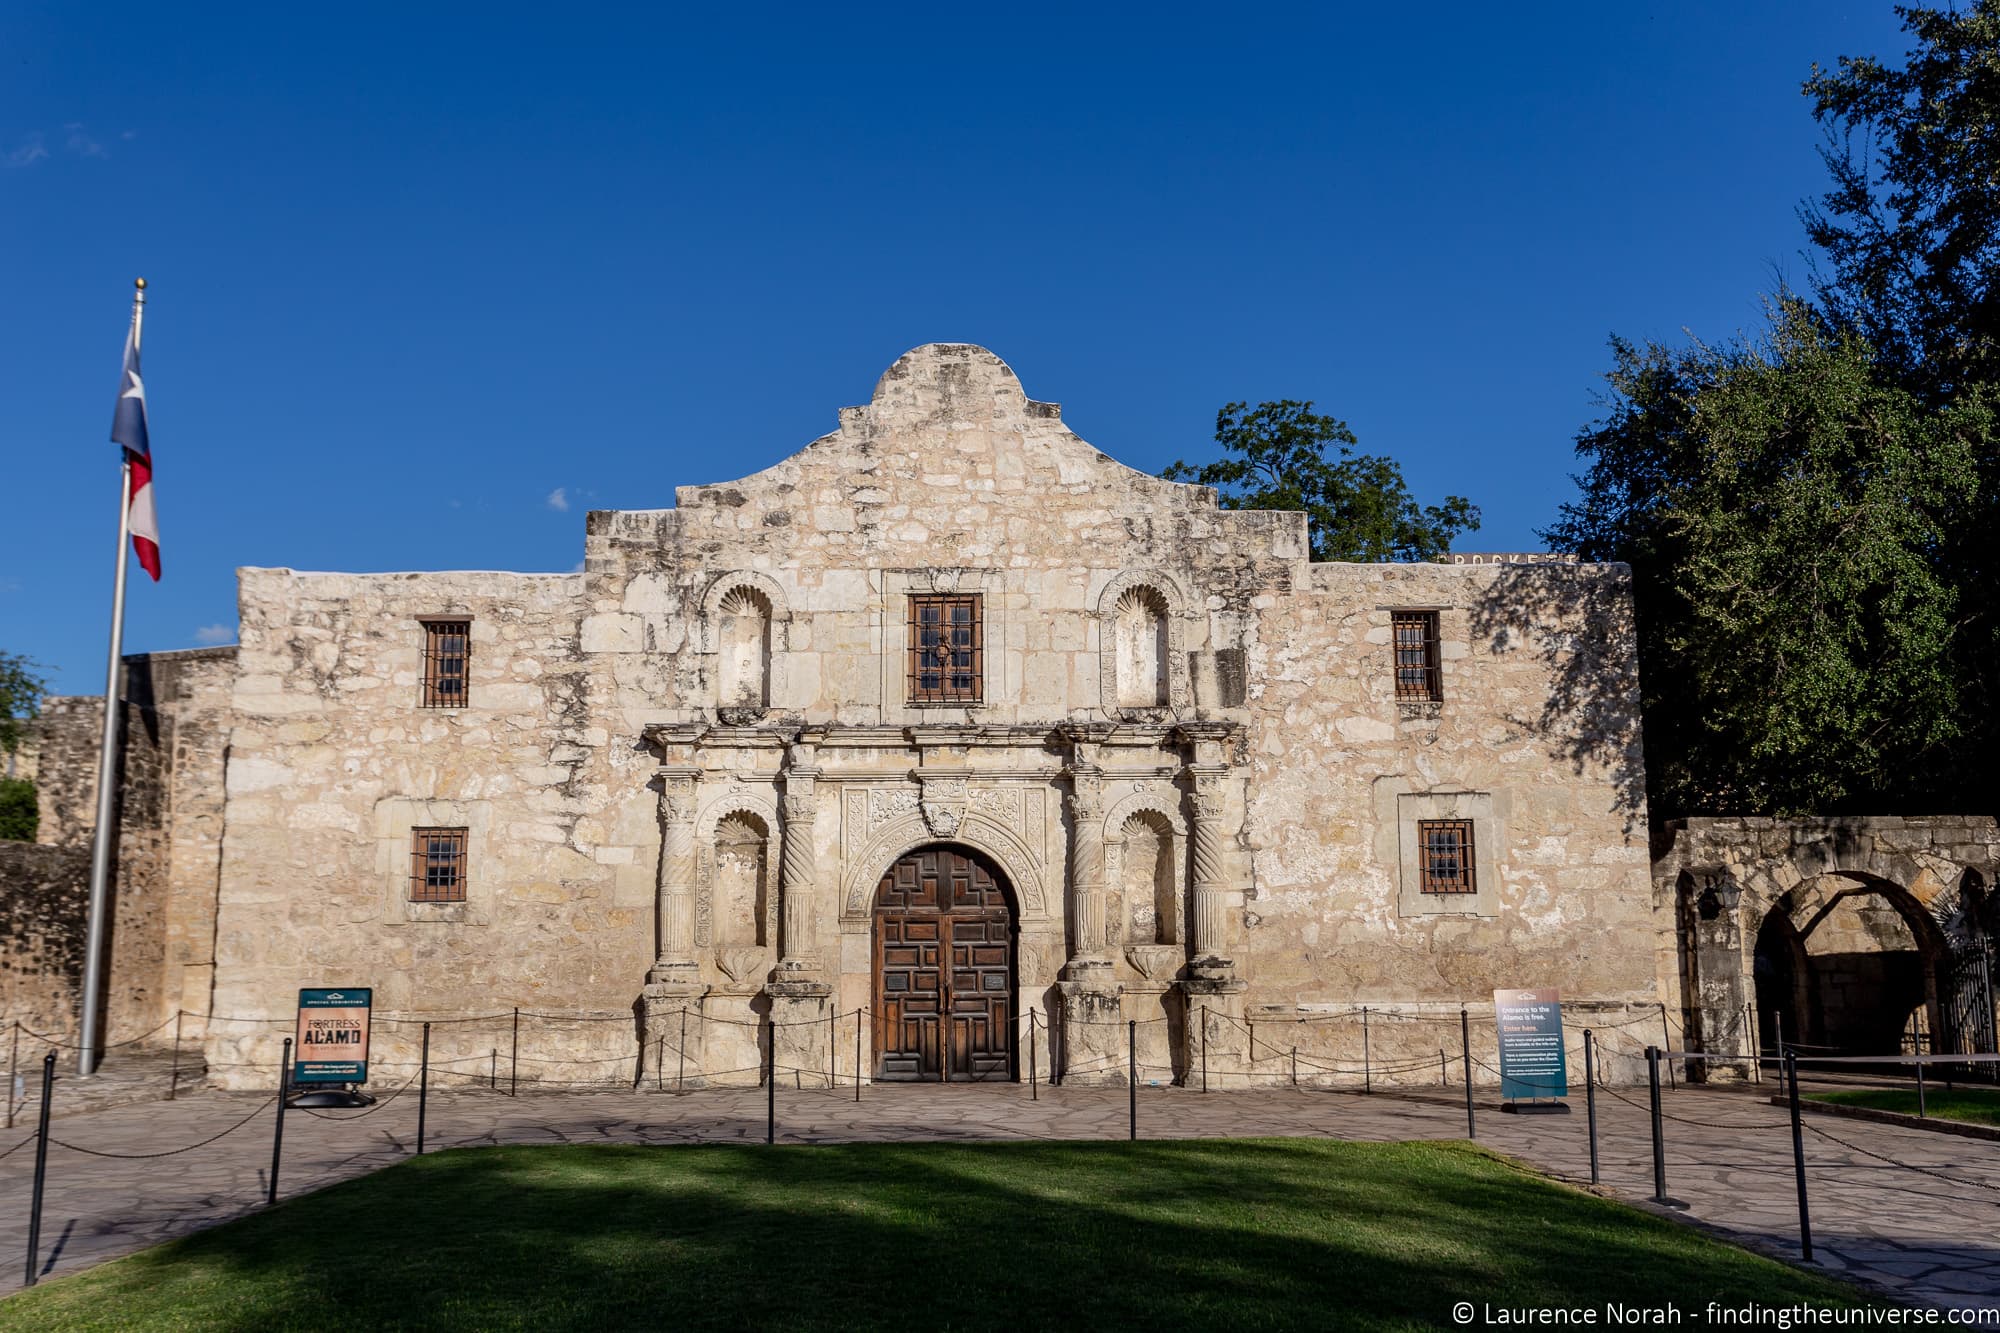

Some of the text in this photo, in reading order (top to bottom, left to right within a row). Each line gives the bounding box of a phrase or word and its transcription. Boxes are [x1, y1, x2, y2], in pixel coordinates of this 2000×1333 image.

[1539, 1005, 1550, 1013] the
[308, 1019, 361, 1028] FORTRESS
[304, 1030, 361, 1044] ALAMO
